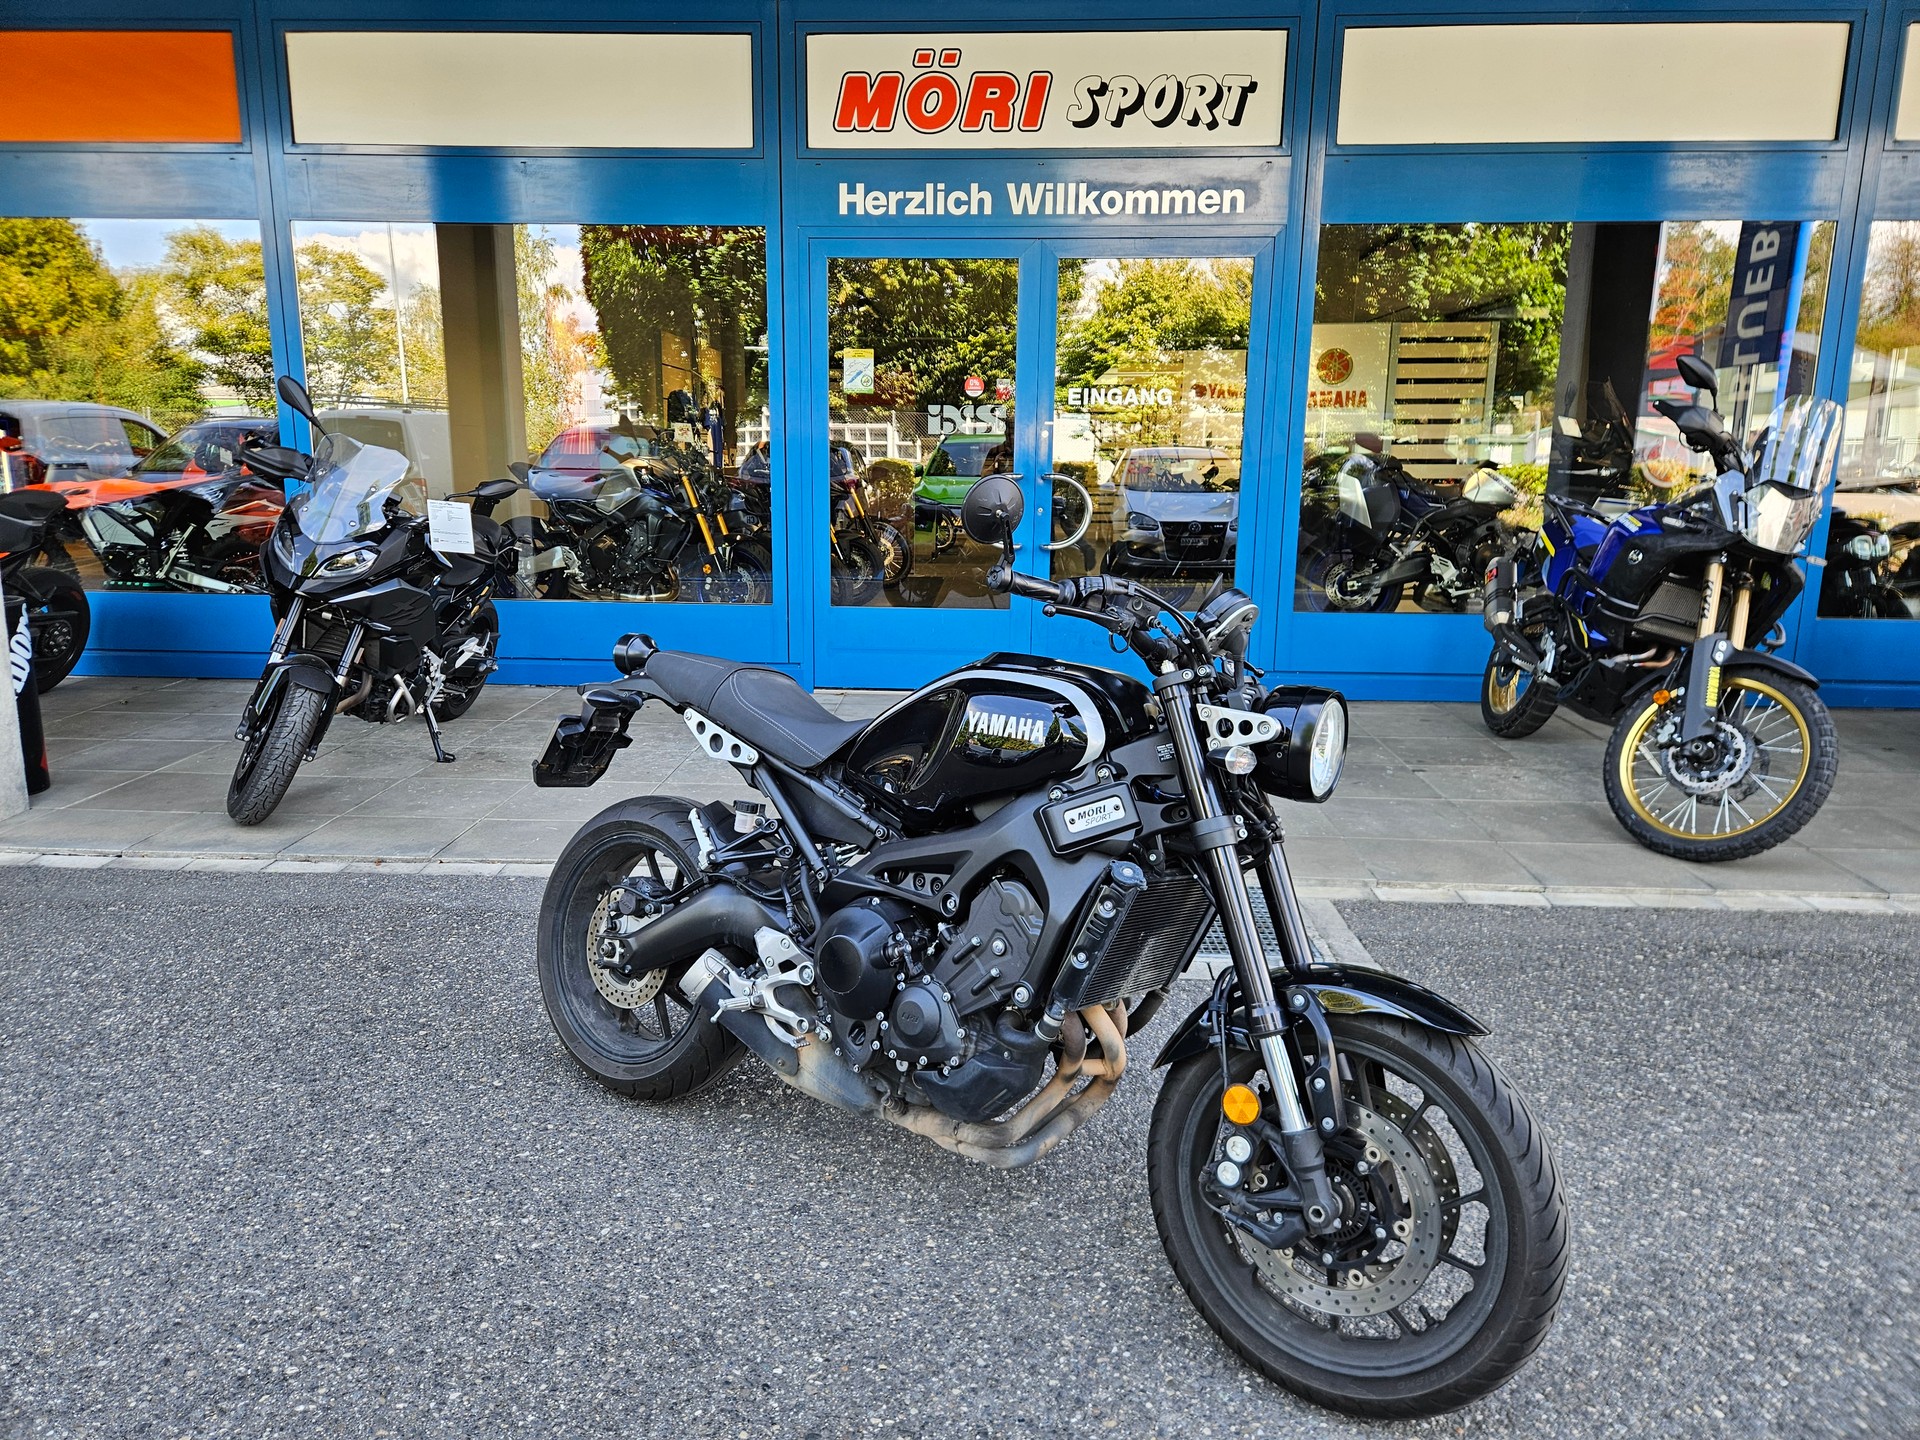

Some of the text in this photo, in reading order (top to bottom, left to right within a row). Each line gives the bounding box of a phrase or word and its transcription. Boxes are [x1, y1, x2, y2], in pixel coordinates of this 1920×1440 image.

[833, 48, 1258, 134] MÖRI SPORT
[838, 181, 1246, 216] Herzlich Willkommen
[1068, 387, 1173, 406] EINGANG
[1308, 390, 1368, 408] AMAHA
[968, 710, 1045, 745] YAMAHA
[1077, 804, 1107, 820] MÖRI
[1085, 811, 1114, 827] SPORT
